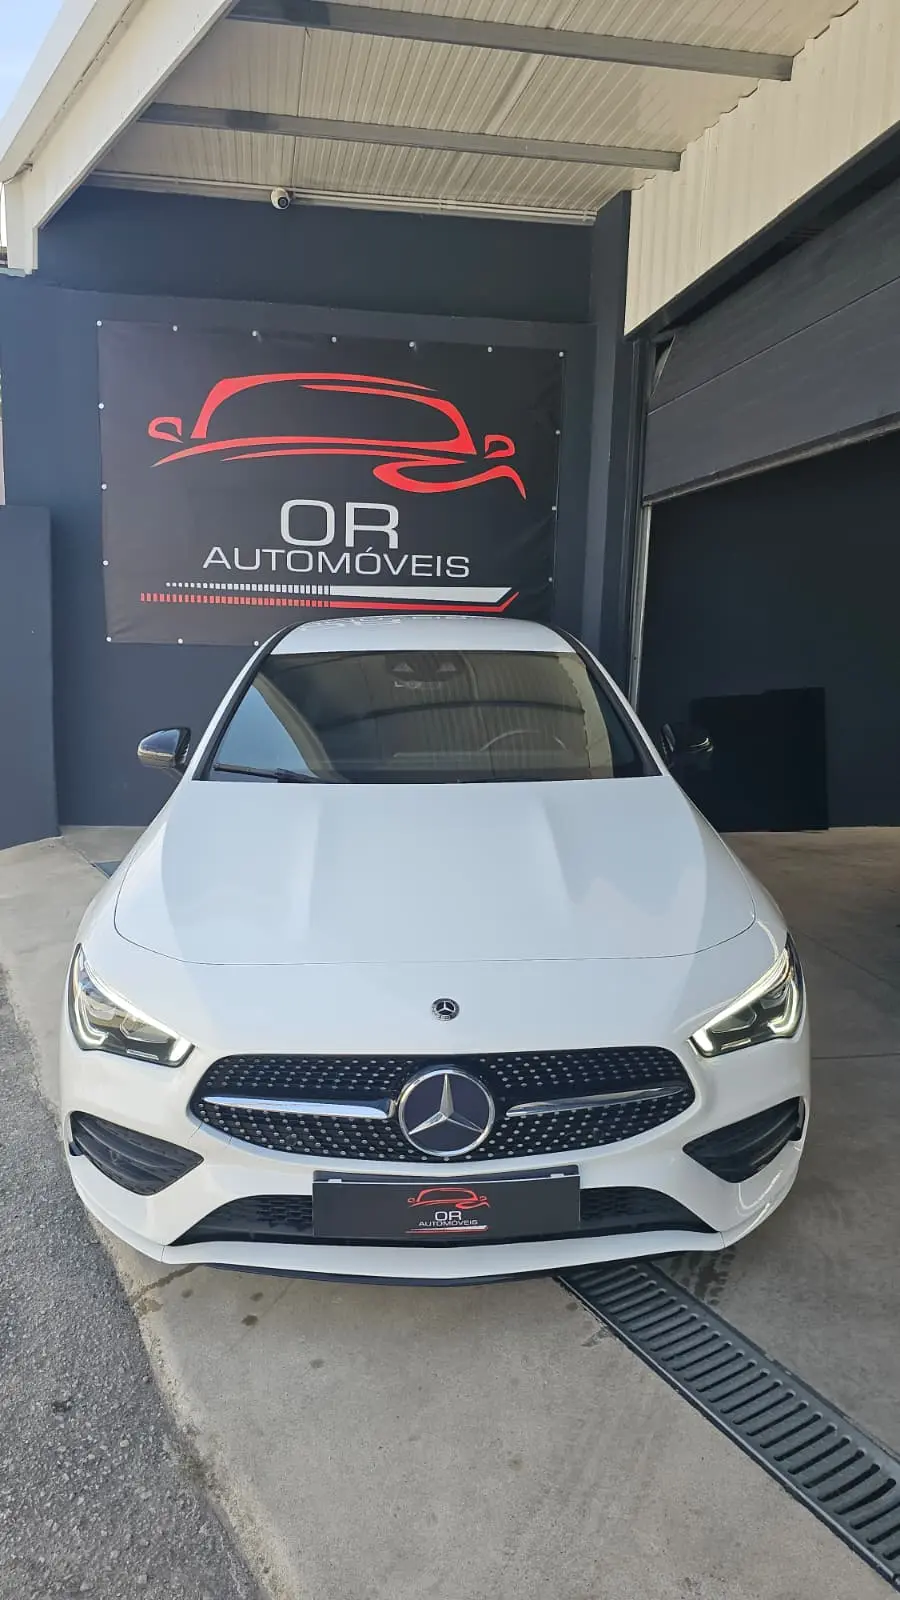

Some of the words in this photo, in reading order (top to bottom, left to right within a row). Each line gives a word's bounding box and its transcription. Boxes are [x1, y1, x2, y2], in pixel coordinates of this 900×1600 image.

[280, 499, 399, 549] OR
[202, 546, 470, 578] AUTOMÓVEIS
[434, 1210, 462, 1221] OR
